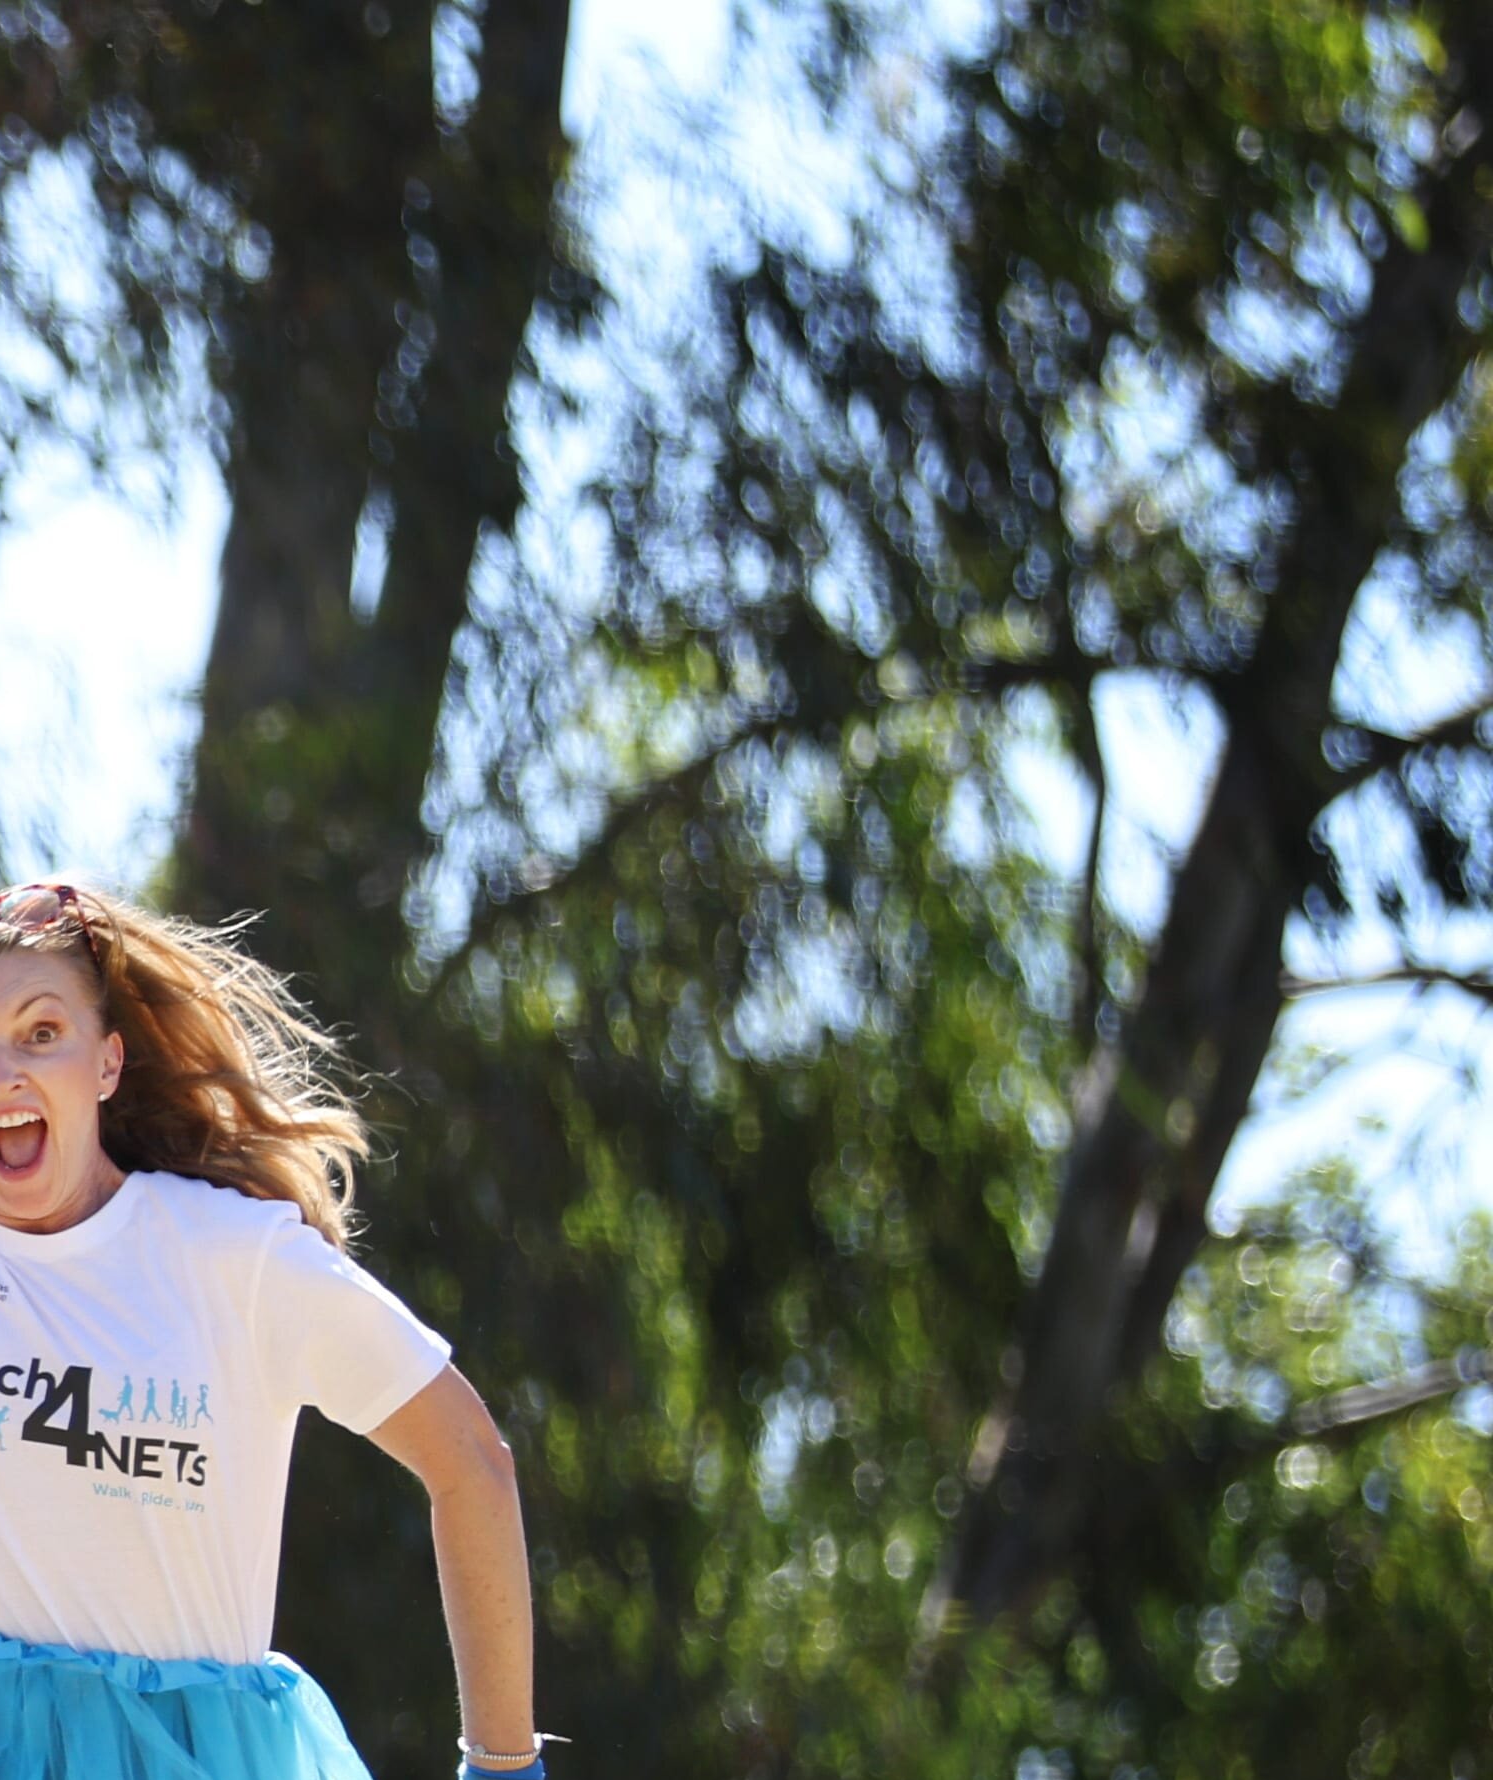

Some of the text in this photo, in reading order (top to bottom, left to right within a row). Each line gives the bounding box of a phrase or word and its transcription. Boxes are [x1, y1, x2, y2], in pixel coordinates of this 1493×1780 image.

[93, 1431, 208, 1487] NETs
[92, 1482, 131, 1499] Walk
[184, 1499, 205, 1512] un
